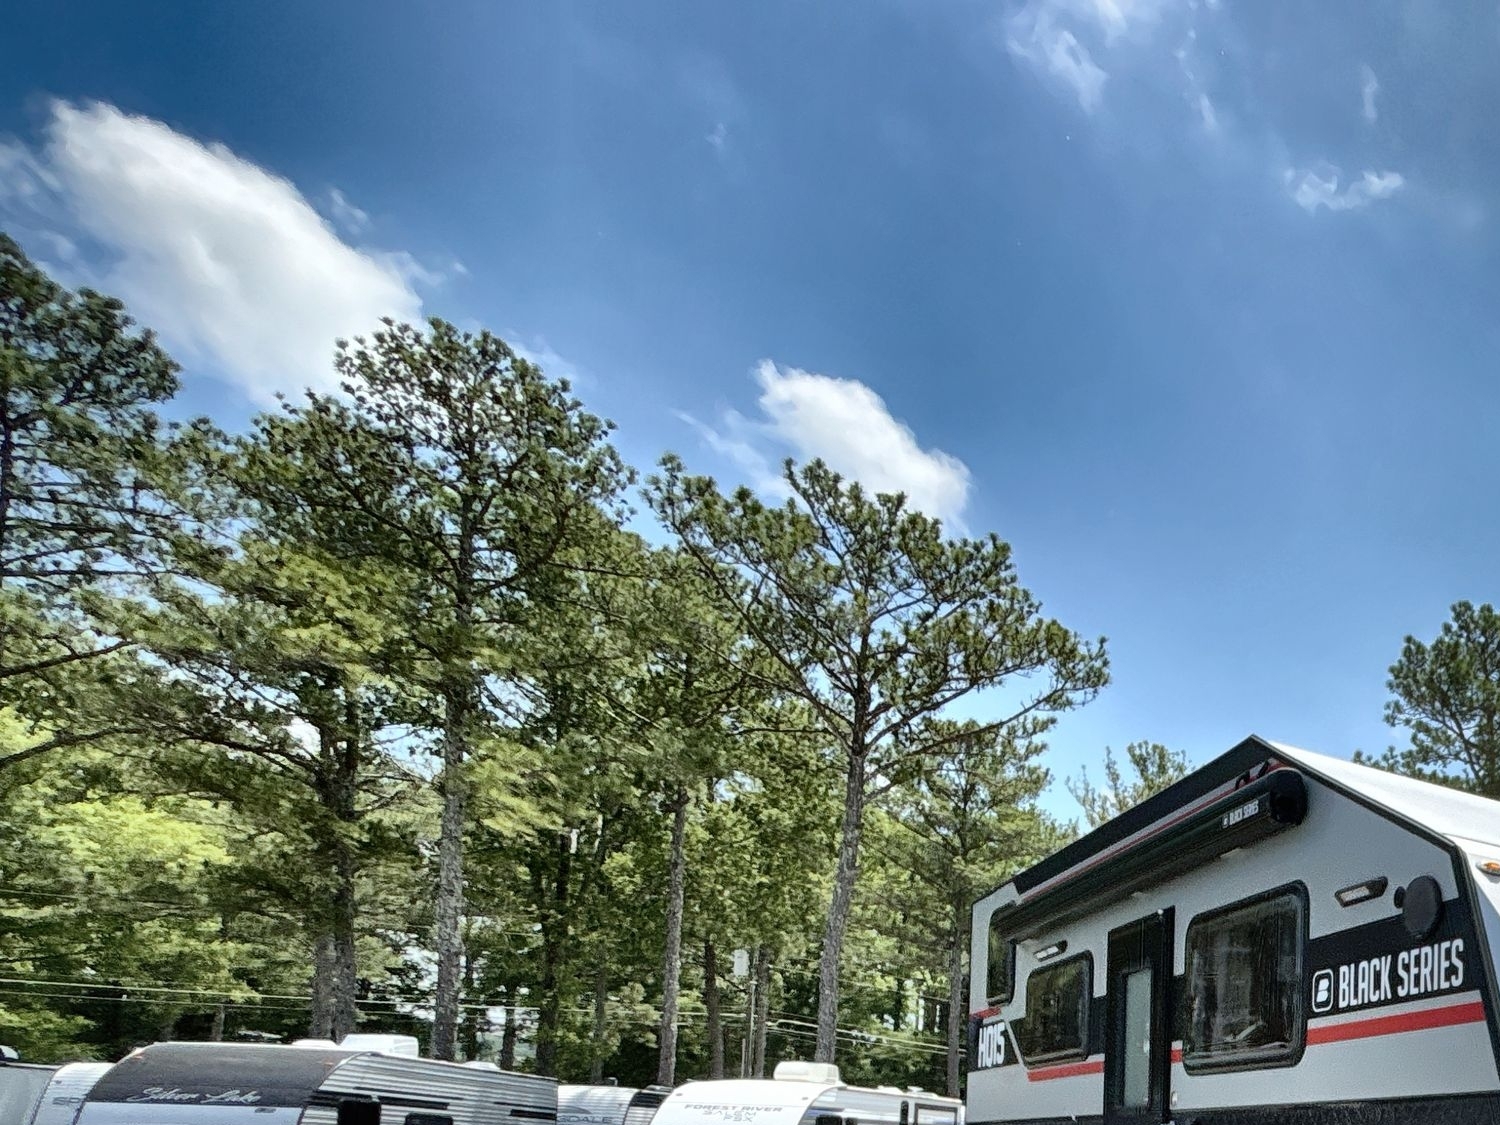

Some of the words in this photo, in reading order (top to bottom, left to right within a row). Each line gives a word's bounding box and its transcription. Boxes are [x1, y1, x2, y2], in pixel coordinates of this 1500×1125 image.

[1338, 954, 1392, 1009] BLACK
[1397, 938, 1464, 998] SERIES
[126, 1086, 200, 1103] Silver
[200, 1089, 262, 1104] Lake
[684, 1103, 738, 1112] FOREST
[740, 1105, 783, 1113] RIVER
